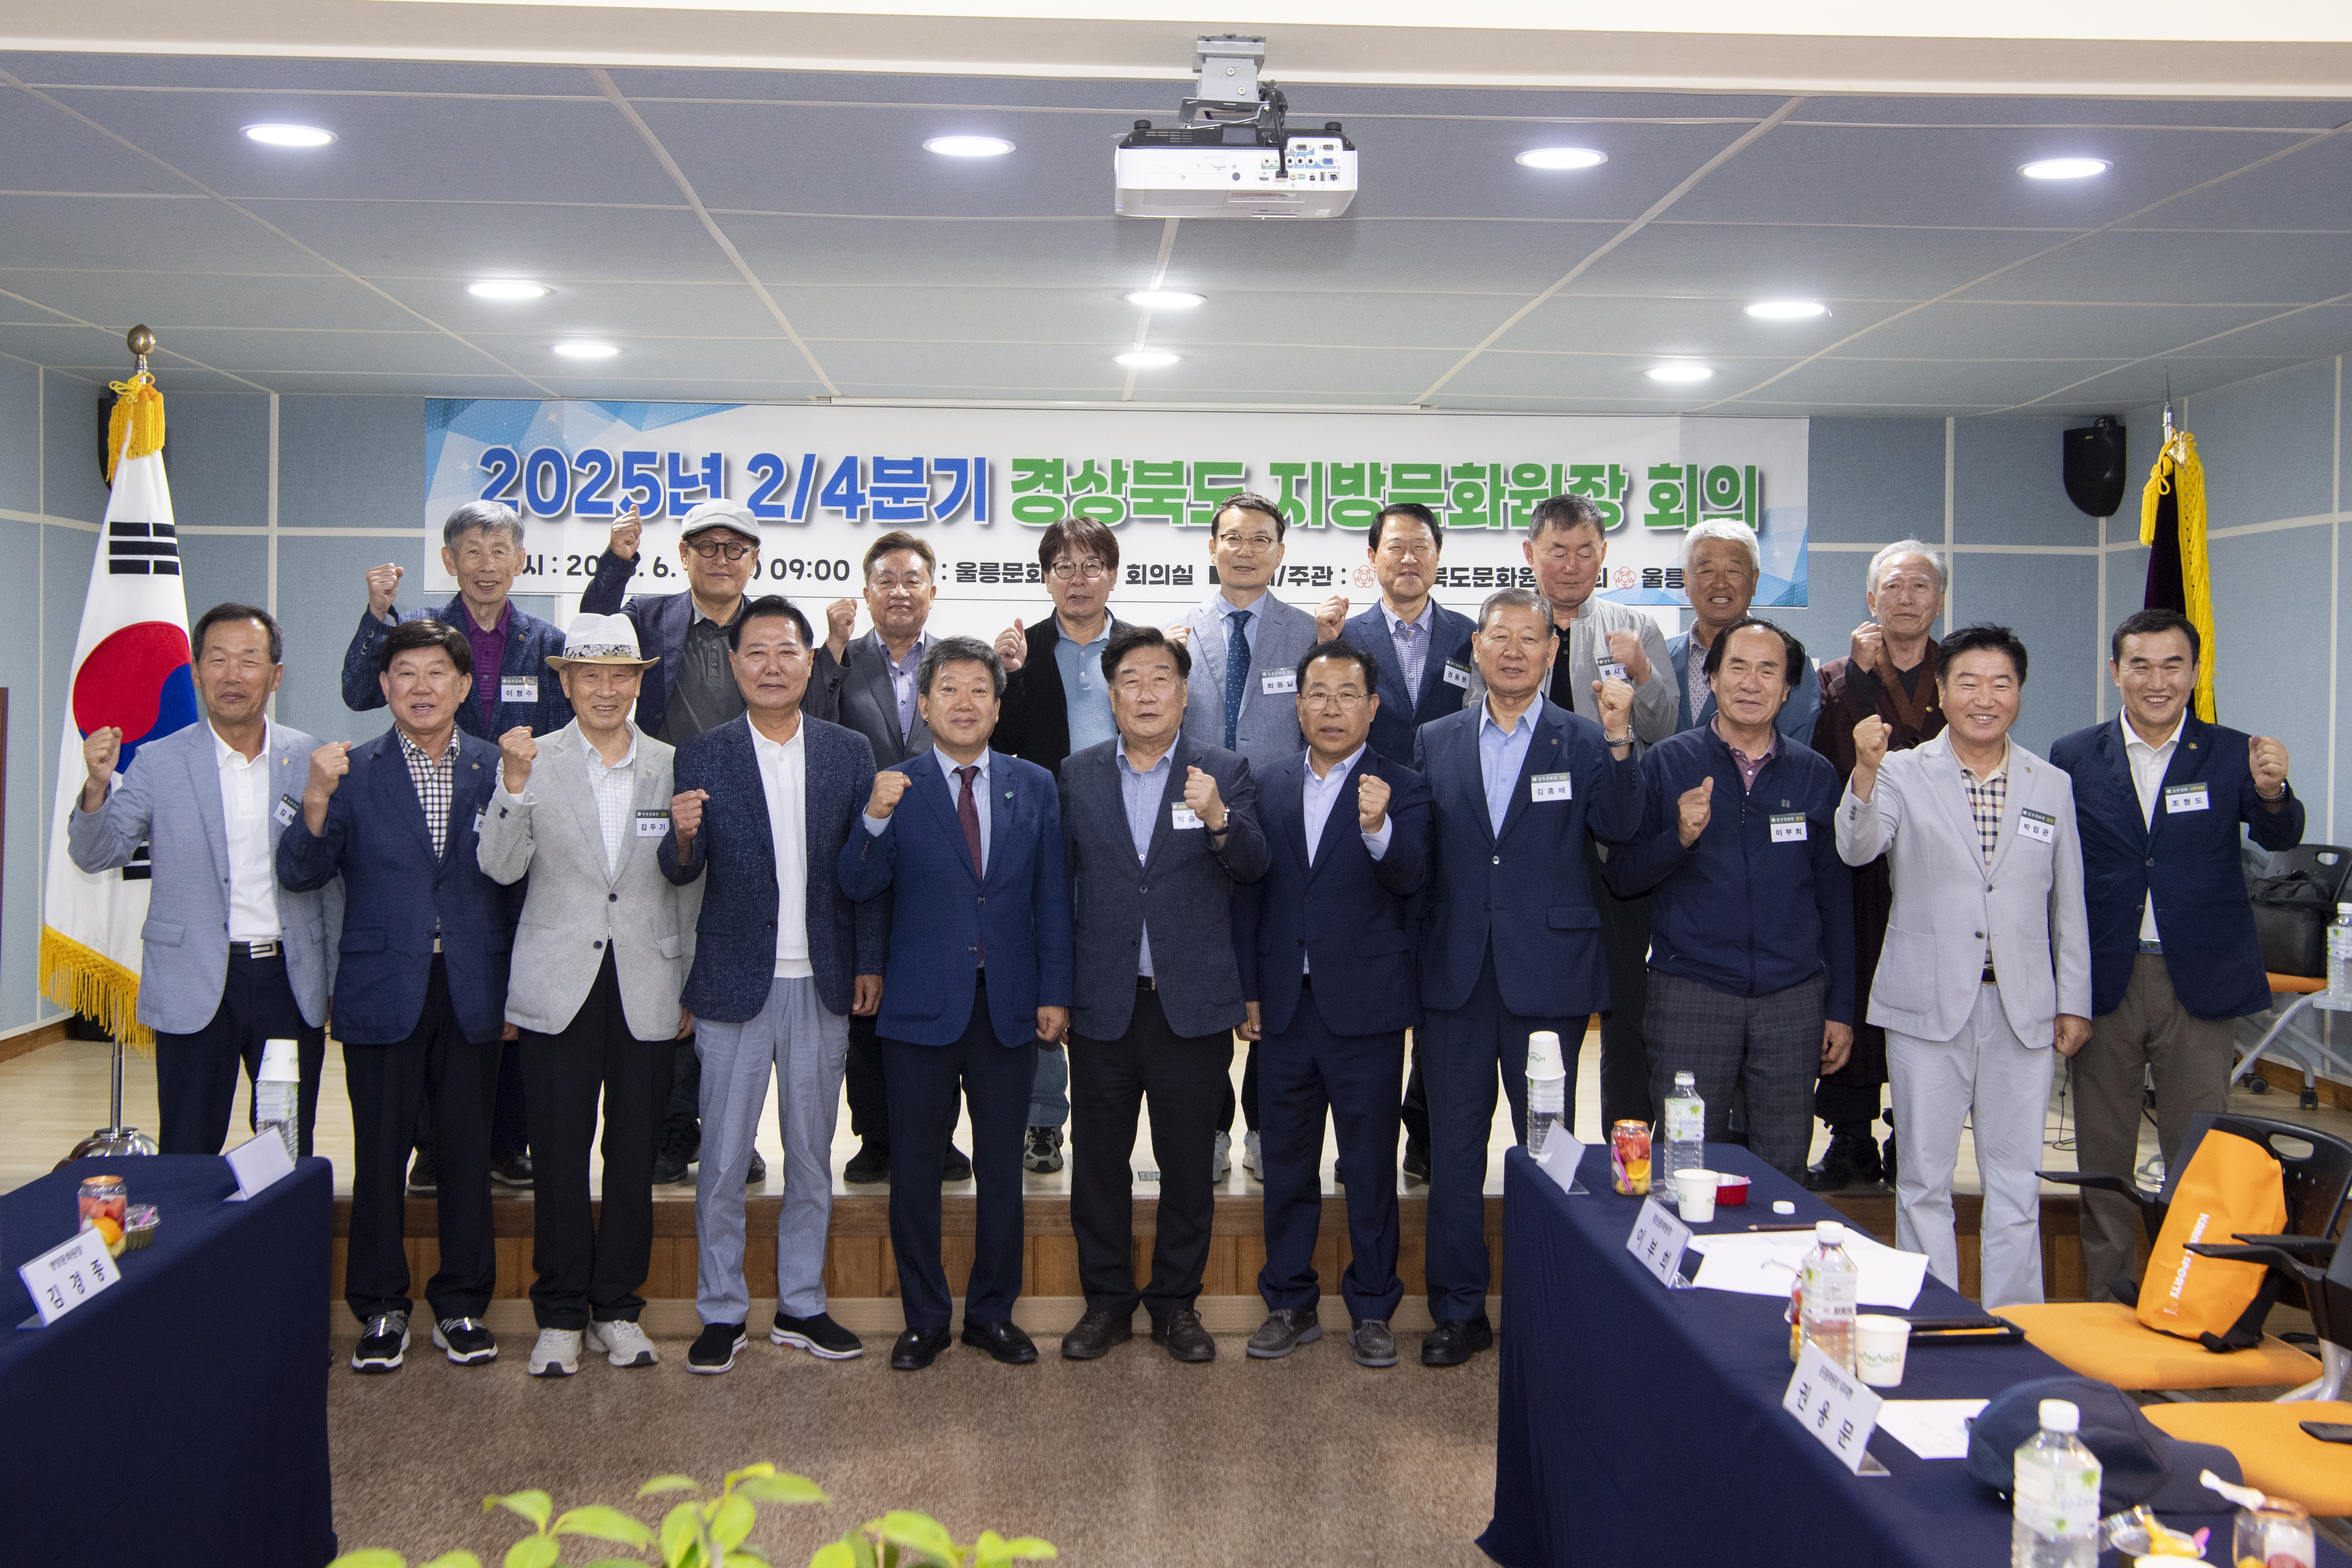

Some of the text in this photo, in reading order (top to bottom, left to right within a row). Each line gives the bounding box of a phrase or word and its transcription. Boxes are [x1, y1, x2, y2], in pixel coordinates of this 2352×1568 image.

[477, 445, 1759, 532] 2025년 2/4분기 경상북도 지방문화원장 회의
[770, 558, 850, 580] 09:00
[955, 562, 1046, 584] 울릉문화
[1125, 564, 1194, 585] 회의실
[1268, 565, 1333, 587] /주관
[1641, 567, 1686, 589] 울릉
[2169, 1255, 2192, 1300] SPORTS
